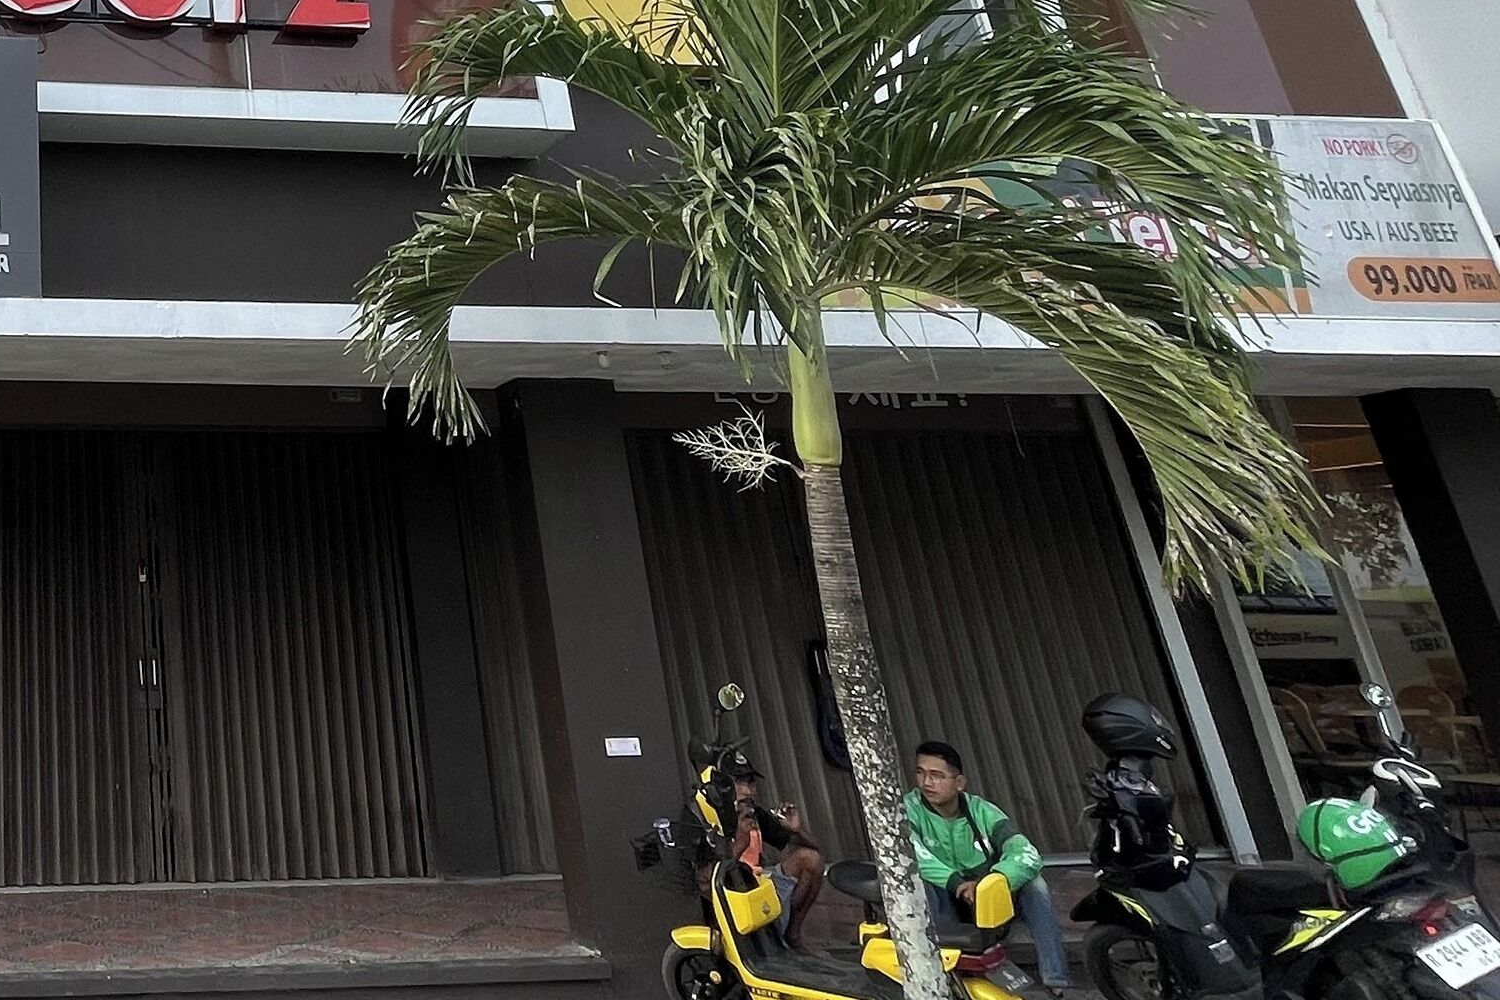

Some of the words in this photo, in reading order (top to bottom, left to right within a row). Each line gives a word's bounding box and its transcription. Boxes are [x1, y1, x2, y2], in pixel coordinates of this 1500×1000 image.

[1322, 138, 1344, 156] NO
[1301, 173, 1366, 201] Makan
[1363, 174, 1466, 211] Sepuasnya
[1337, 219, 1375, 241] USA
[1386, 221, 1418, 242] AUS
[1420, 222, 1459, 243] BEEF
[1363, 264, 1458, 296] 99.000
